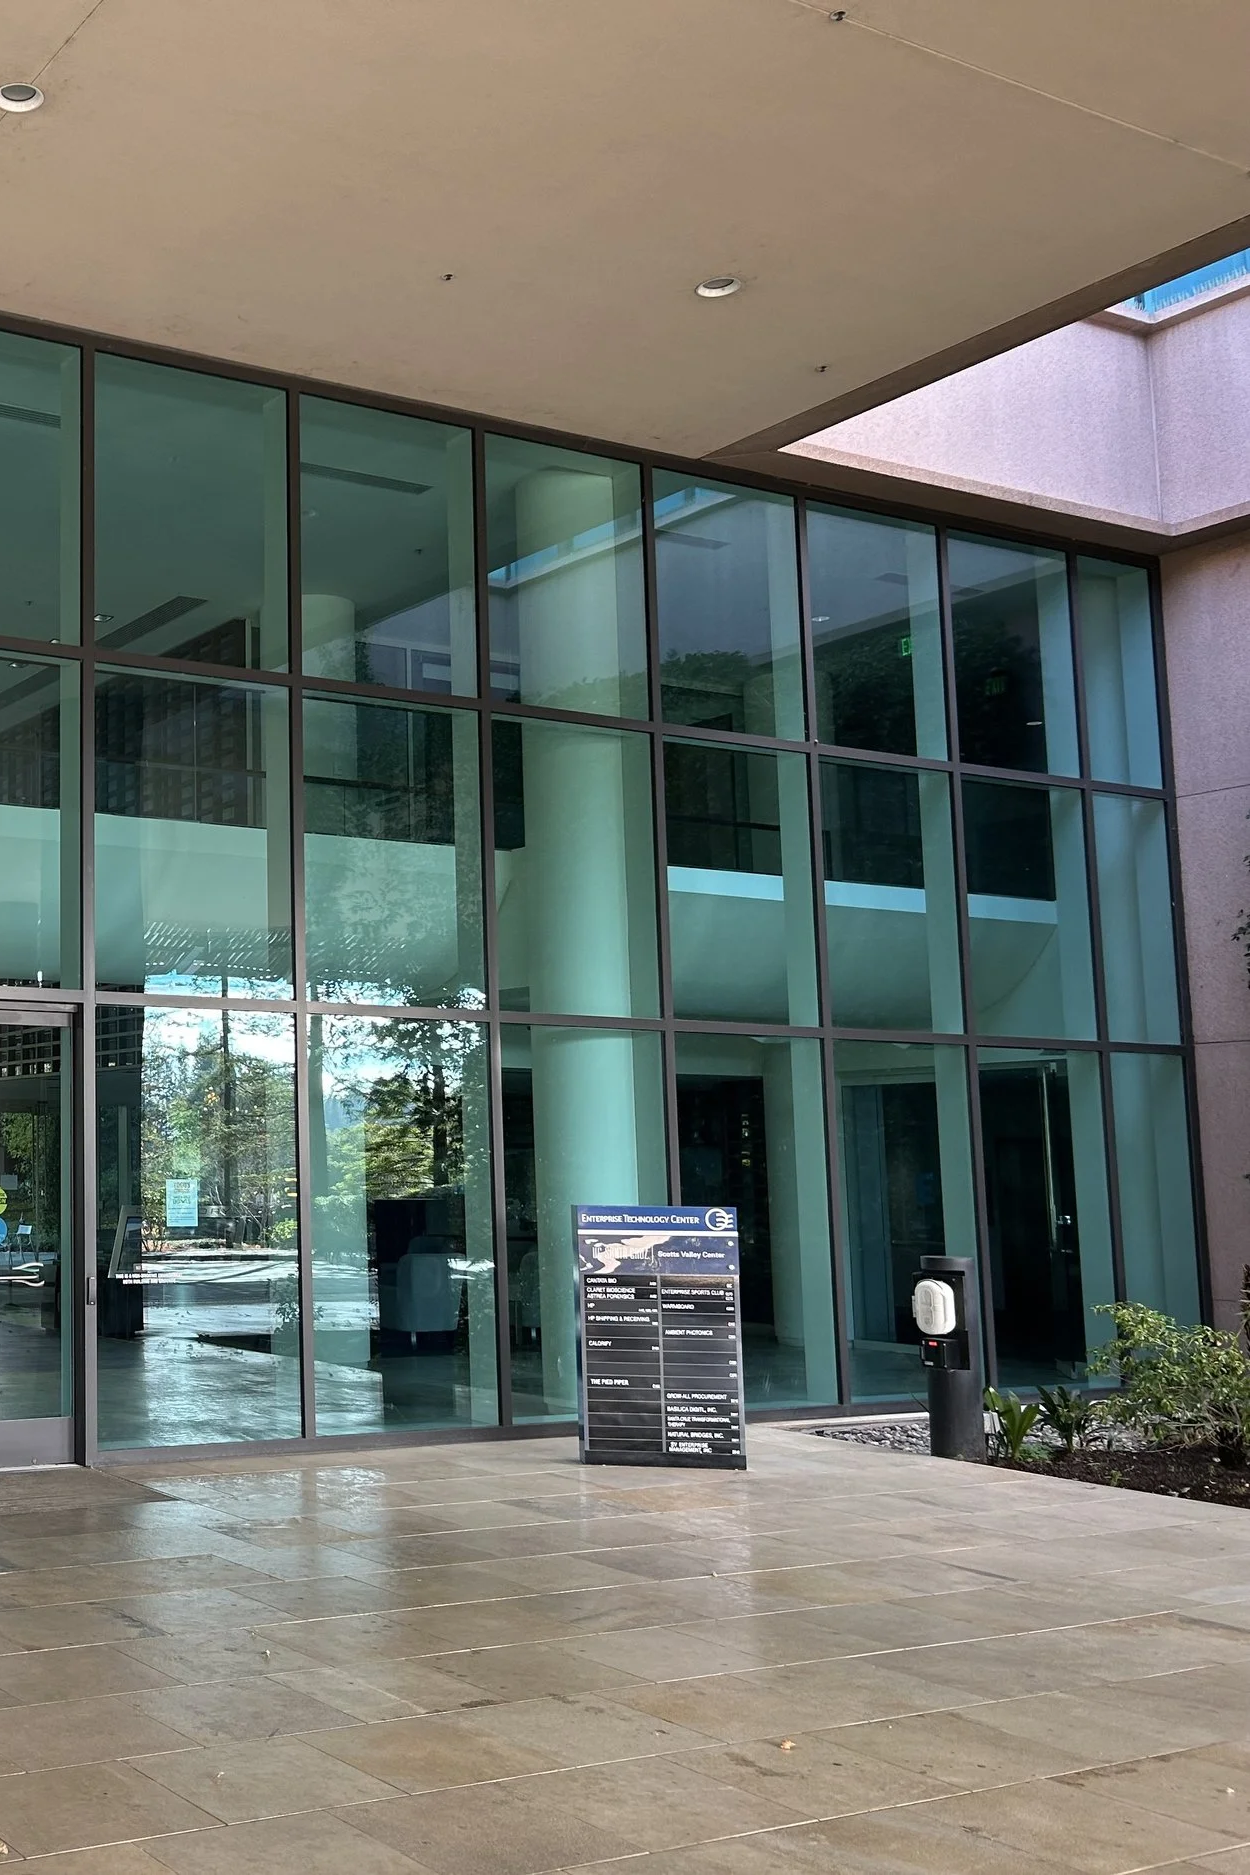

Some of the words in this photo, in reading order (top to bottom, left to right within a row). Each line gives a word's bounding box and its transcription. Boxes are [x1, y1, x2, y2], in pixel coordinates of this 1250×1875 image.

[582, 1214, 623, 1222] ENTERPRISE
[622, 1214, 670, 1224] TECHNOLOGY
[670, 1215, 700, 1224] CENTER
[680, 1251, 701, 1260] Valley
